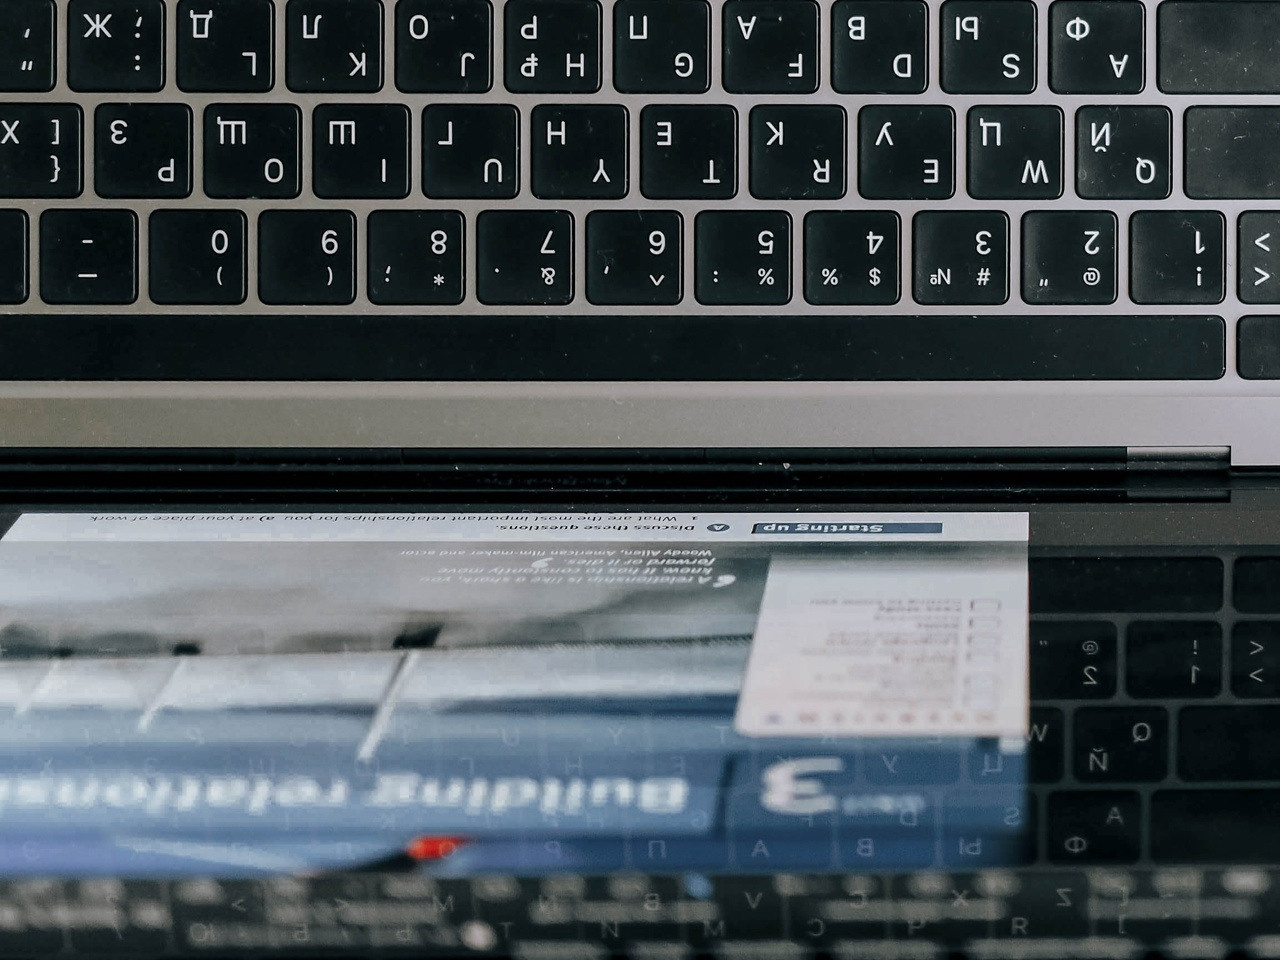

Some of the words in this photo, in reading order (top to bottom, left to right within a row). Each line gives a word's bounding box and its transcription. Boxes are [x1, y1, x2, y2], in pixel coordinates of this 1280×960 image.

[241, 51, 257, 76] L
[348, 52, 366, 77] K
[460, 52, 476, 77] J
[566, 52, 585, 77] H
[674, 52, 694, 78] G
[787, 53, 803, 78] F
[892, 53, 912, 78] D
[1002, 53, 1021, 79] S
[1108, 54, 1129, 79] A
[157, 158, 175, 182] P
[264, 158, 284, 183] O
[484, 158, 503, 183] U
[592, 158, 611, 183] Y
[702, 159, 721, 184] T
[813, 158, 830, 183] R
[923, 159, 939, 184] E
[1021, 159, 1049, 184] W
[1135, 156, 1156, 184] Q
[211, 229, 229, 254] 0
[321, 229, 339, 255] 9
[430, 229, 448, 255] 8
[540, 230, 556, 254] 7
[648, 230, 666, 255] 6
[757, 230, 774, 255] 5
[866, 230, 884, 255] 4
[975, 230, 992, 255] 3
[1083, 230, 1100, 255] 2
[1195, 230, 1206, 255] 1
[796, 523, 884, 533] Starting
[400, 549, 435, 557] actor
[440, 549, 465, 557] and
[471, 549, 546, 557] film-maker
[551, 549, 616, 557] American
[621, 549, 660, 557] Allen,
[665, 549, 712, 557] Woody
[369, 772, 690, 814] Building
[761, 757, 843, 815] 3
